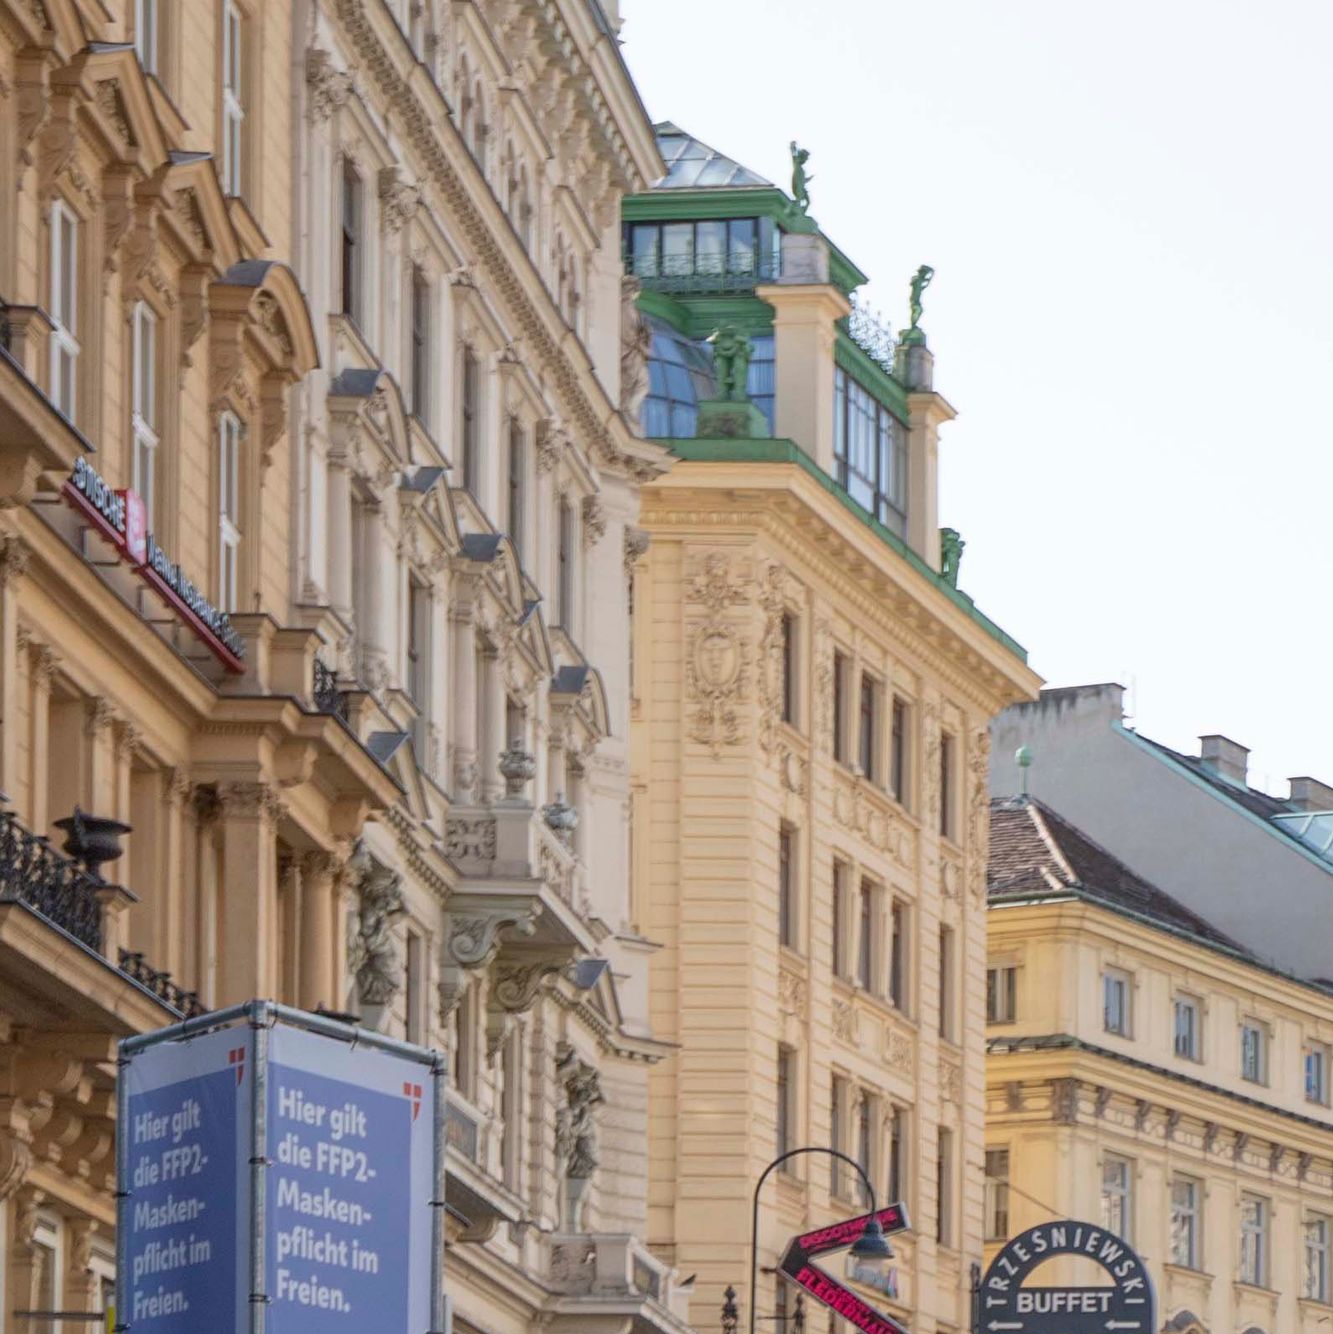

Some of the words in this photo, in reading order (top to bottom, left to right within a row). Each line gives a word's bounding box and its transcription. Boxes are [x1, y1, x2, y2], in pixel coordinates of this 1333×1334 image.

[134, 1112, 169, 1144] Hier
[172, 1099, 201, 1143] gilt
[278, 1086, 326, 1127] Hier
[330, 1103, 367, 1139] gilt
[134, 1156, 159, 1188] die
[162, 1143, 209, 1181] FFP2-
[277, 1133, 312, 1169] die
[316, 1142, 377, 1182] FFP2-
[133, 1195, 206, 1233] Masken-
[277, 1178, 372, 1226] Masken-
[133, 1238, 187, 1286] pflicht
[189, 1234, 212, 1266] im
[276, 1226, 349, 1267] pflicht
[352, 1240, 378, 1273] im
[132, 1286, 189, 1322] Freien.
[276, 1269, 351, 1313] Freien.
[1016, 1291, 1114, 1314] BUFFET
